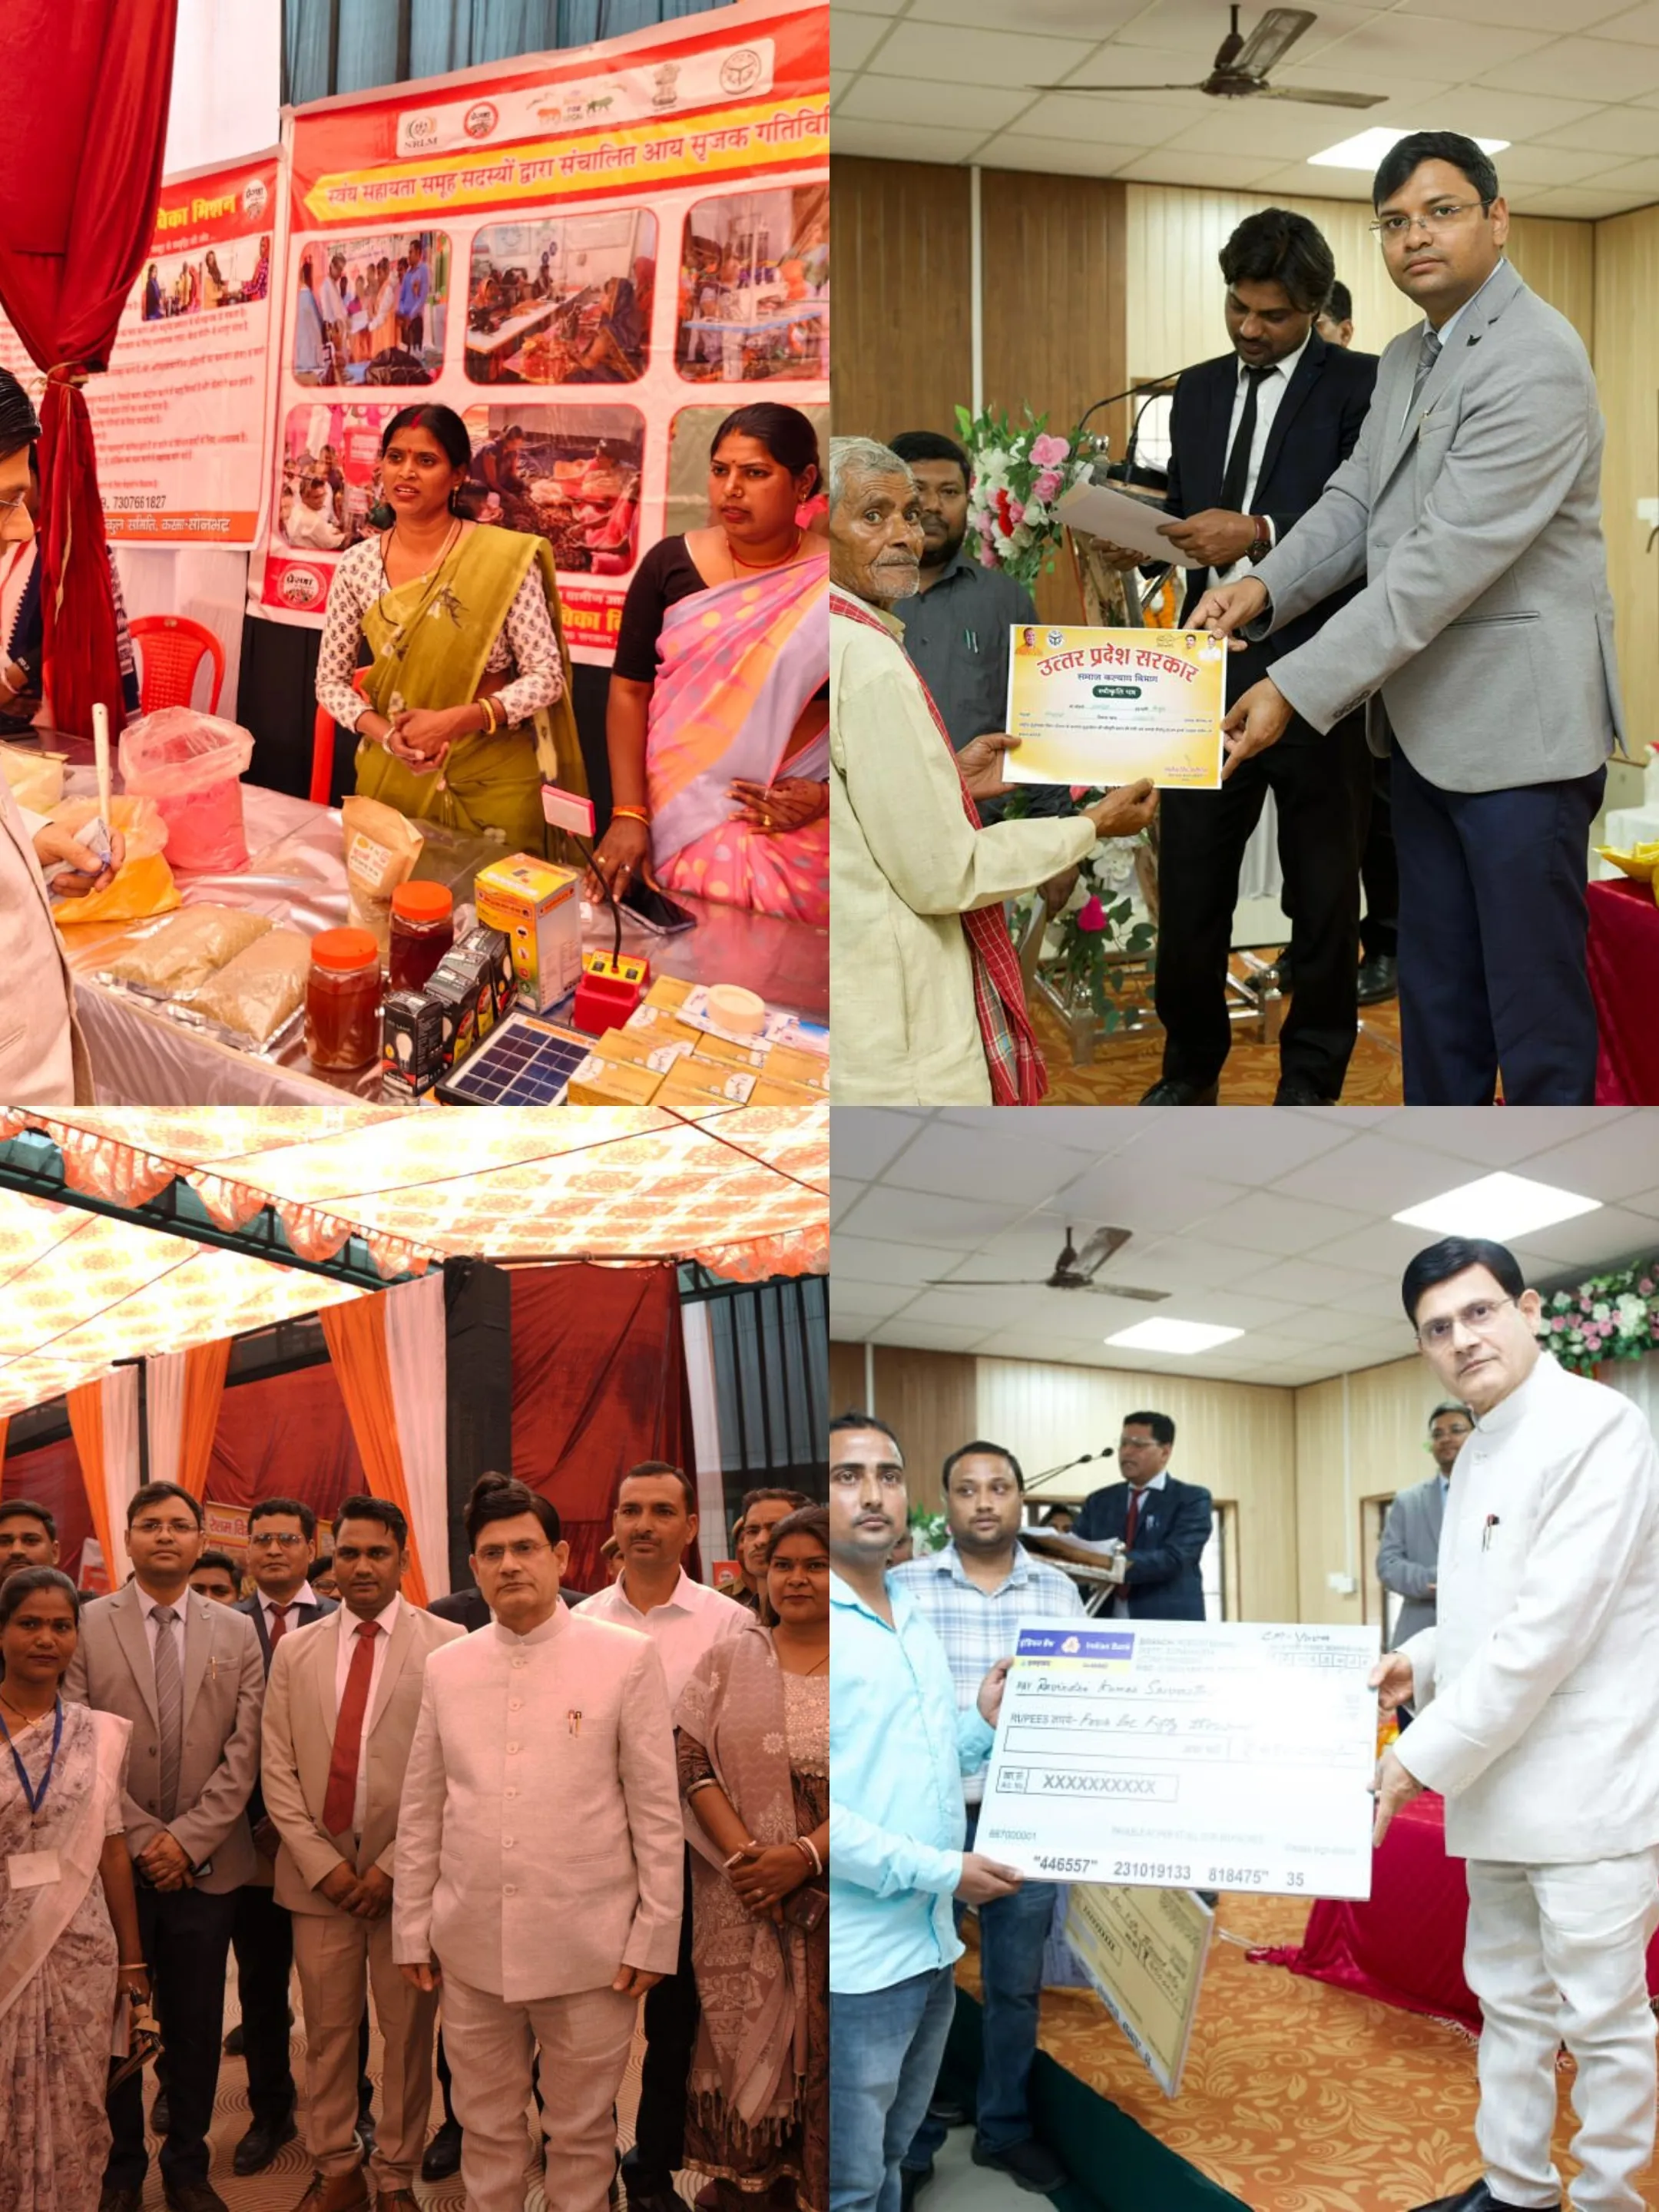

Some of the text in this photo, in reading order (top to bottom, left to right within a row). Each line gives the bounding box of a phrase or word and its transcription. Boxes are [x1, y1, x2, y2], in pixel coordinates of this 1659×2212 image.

[362, 179, 416, 203] सहायता
[421, 173, 459, 200] समूह
[461, 157, 514, 185] सदस्यों
[519, 157, 553, 184] द्वारा
[561, 144, 637, 174] संचालित
[644, 137, 684, 161] आय
[690, 127, 749, 163] सृजक
[191, 195, 236, 223] मिशन
[113, 495, 167, 509] 7307661827
[1037, 643, 1200, 683] उत्तर प्रदेश सरकार
[1085, 1641, 1131, 1651] Indian Bank
[1011, 1714, 1048, 1724] RUPEES
[1034, 1855, 1305, 1886] "446557" 231019133 818475" 35
